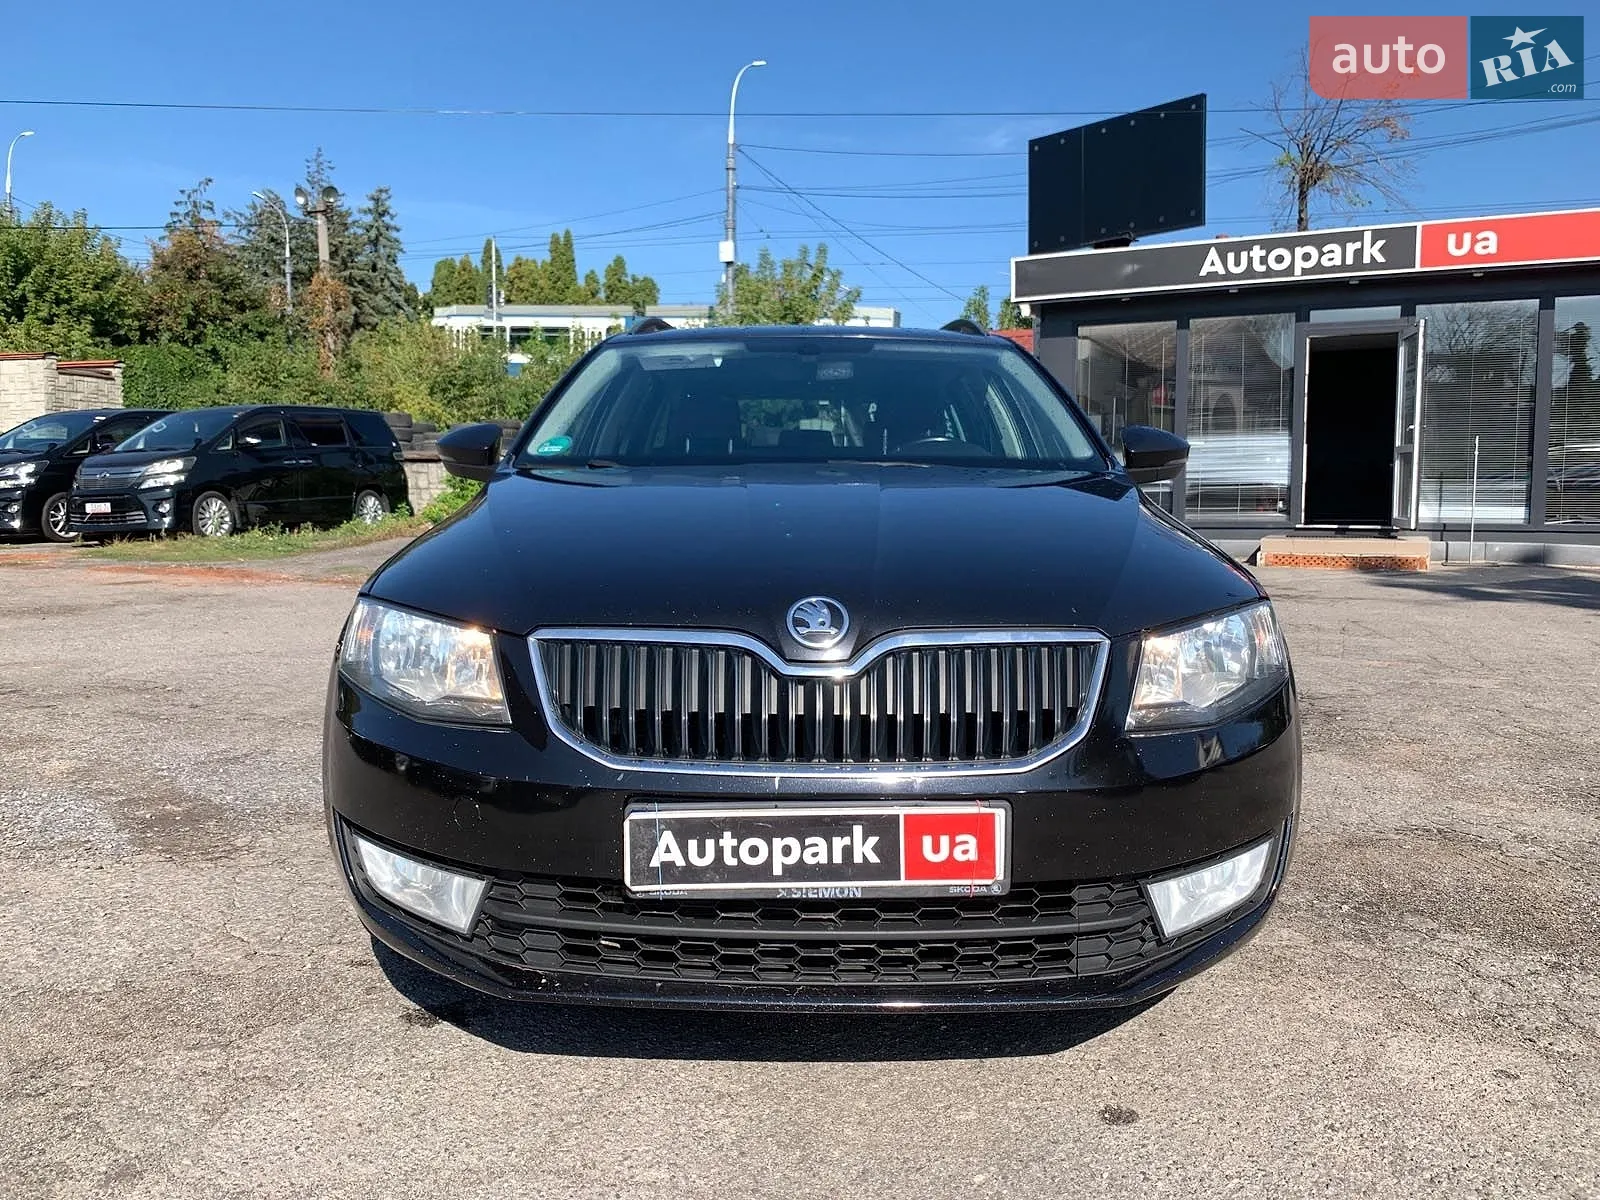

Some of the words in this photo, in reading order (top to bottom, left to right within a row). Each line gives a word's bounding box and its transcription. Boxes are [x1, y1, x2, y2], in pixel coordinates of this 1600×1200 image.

[1199, 231, 1386, 277] Autopark
[1447, 229, 1498, 257] ua
[649, 825, 881, 876] Autopark
[921, 832, 979, 864] ua
